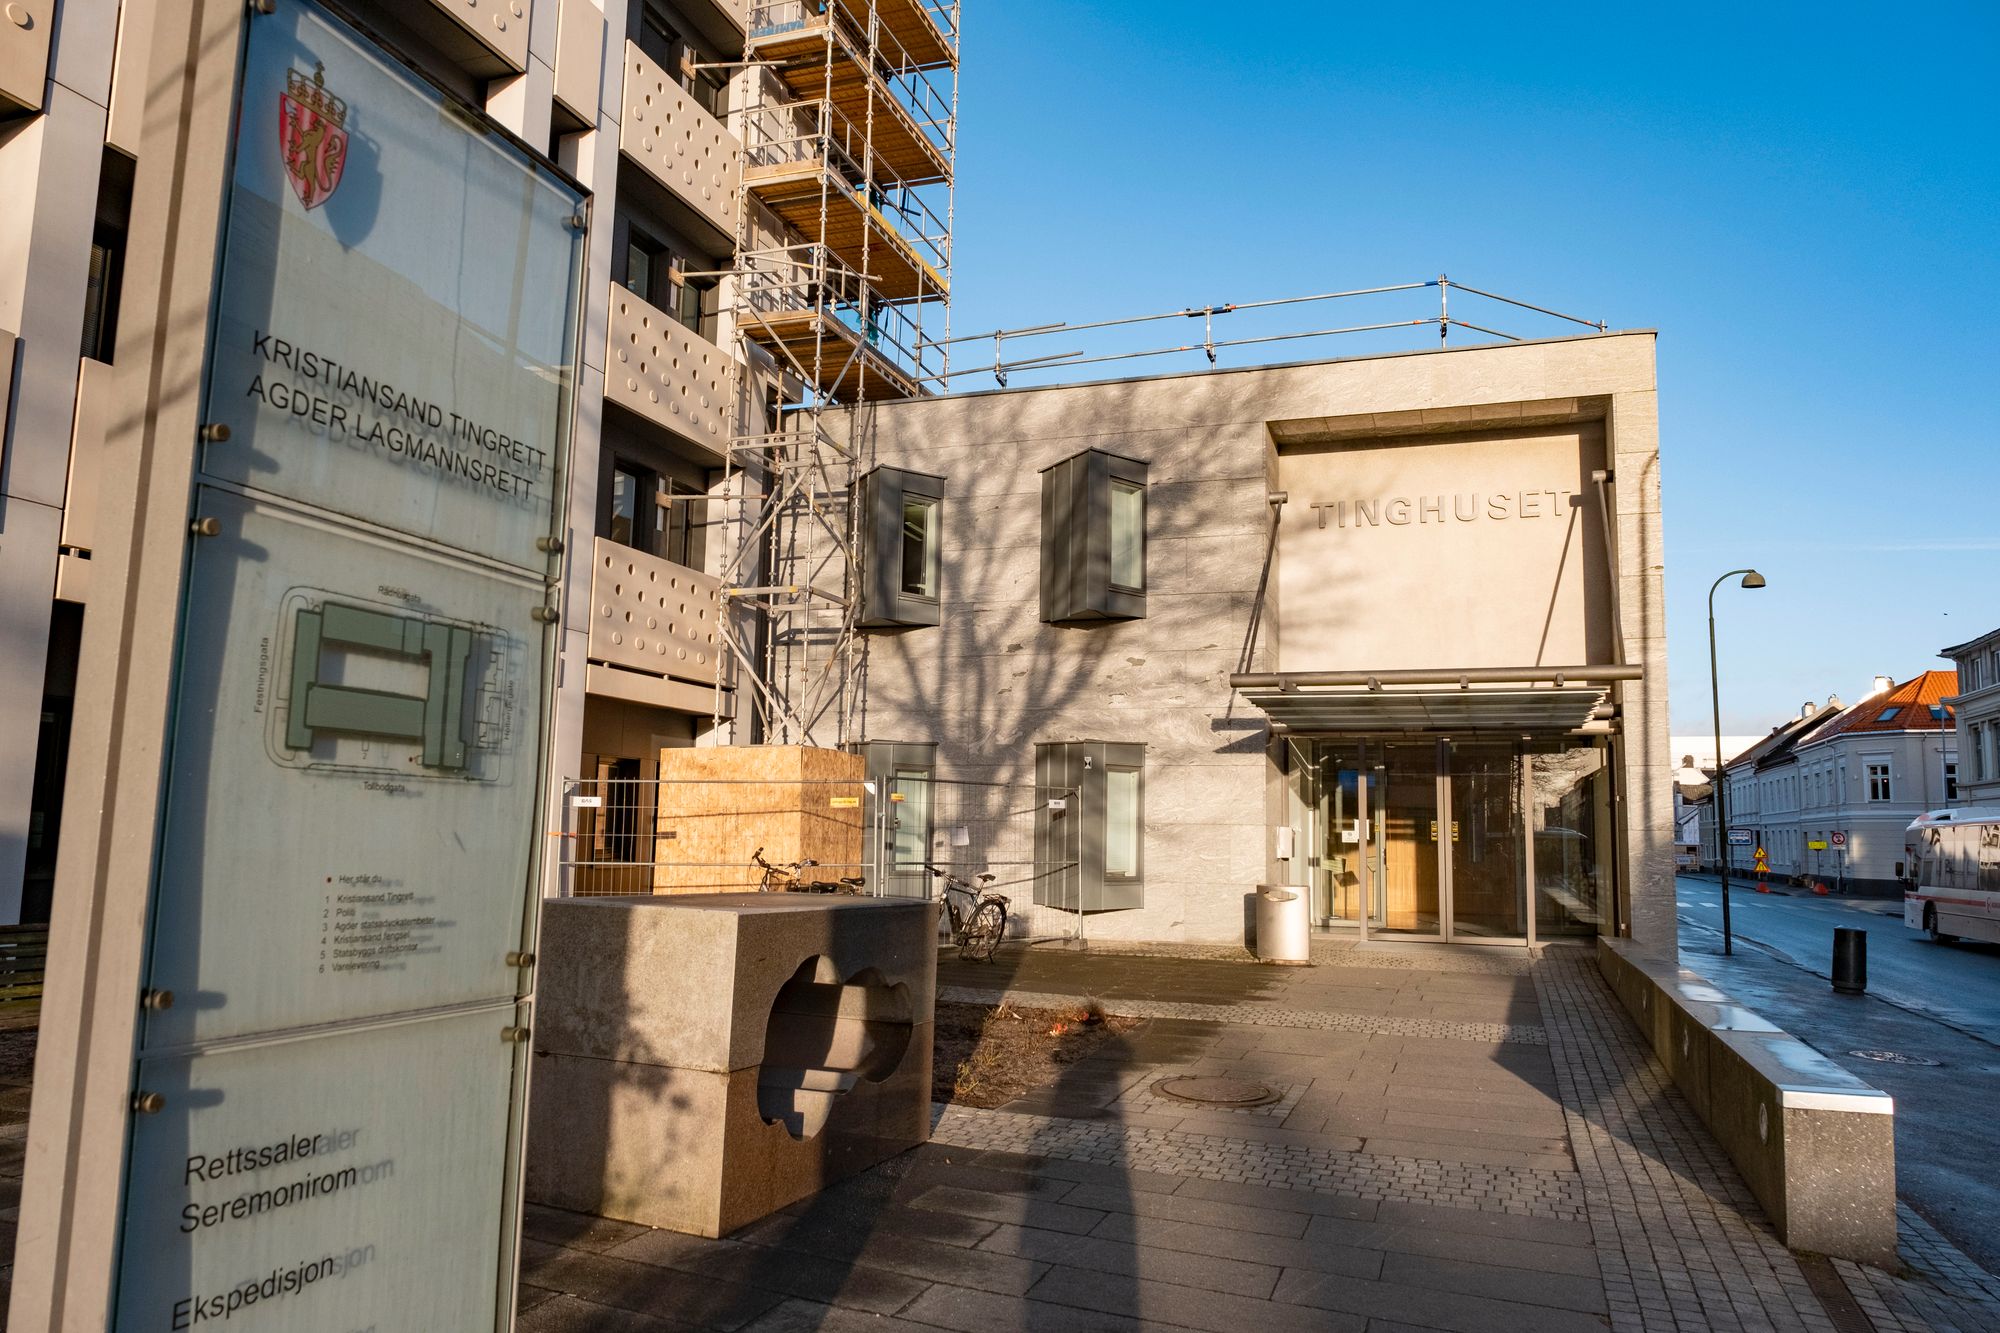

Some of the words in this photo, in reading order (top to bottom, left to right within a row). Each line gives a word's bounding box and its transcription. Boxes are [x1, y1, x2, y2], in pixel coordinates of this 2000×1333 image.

[252, 329, 443, 429] KRISTIANSAND
[449, 412, 547, 472] TINGRETT
[247, 375, 347, 432] AGDER
[356, 414, 533, 500] LAGMANNSRETT
[1310, 489, 1572, 529] TINGHUSET
[253, 637, 269, 713] Festningsgata
[363, 781, 405, 794] Tollbodgata
[338, 874, 353, 885] Her
[371, 874, 382, 883] du
[336, 893, 385, 904] Kristiansand
[322, 909, 329, 918] 2
[322, 923, 328, 932] 3
[334, 922, 358, 932] Agder
[321, 937, 326, 945] 4
[333, 933, 382, 945] Kristiansand
[319, 950, 326, 960] 5
[318, 964, 325, 974] 6
[184, 1133, 323, 1186] Rettssaler
[180, 1166, 357, 1234] Seremonirom
[171, 1257, 334, 1332] Ekspedisjon
